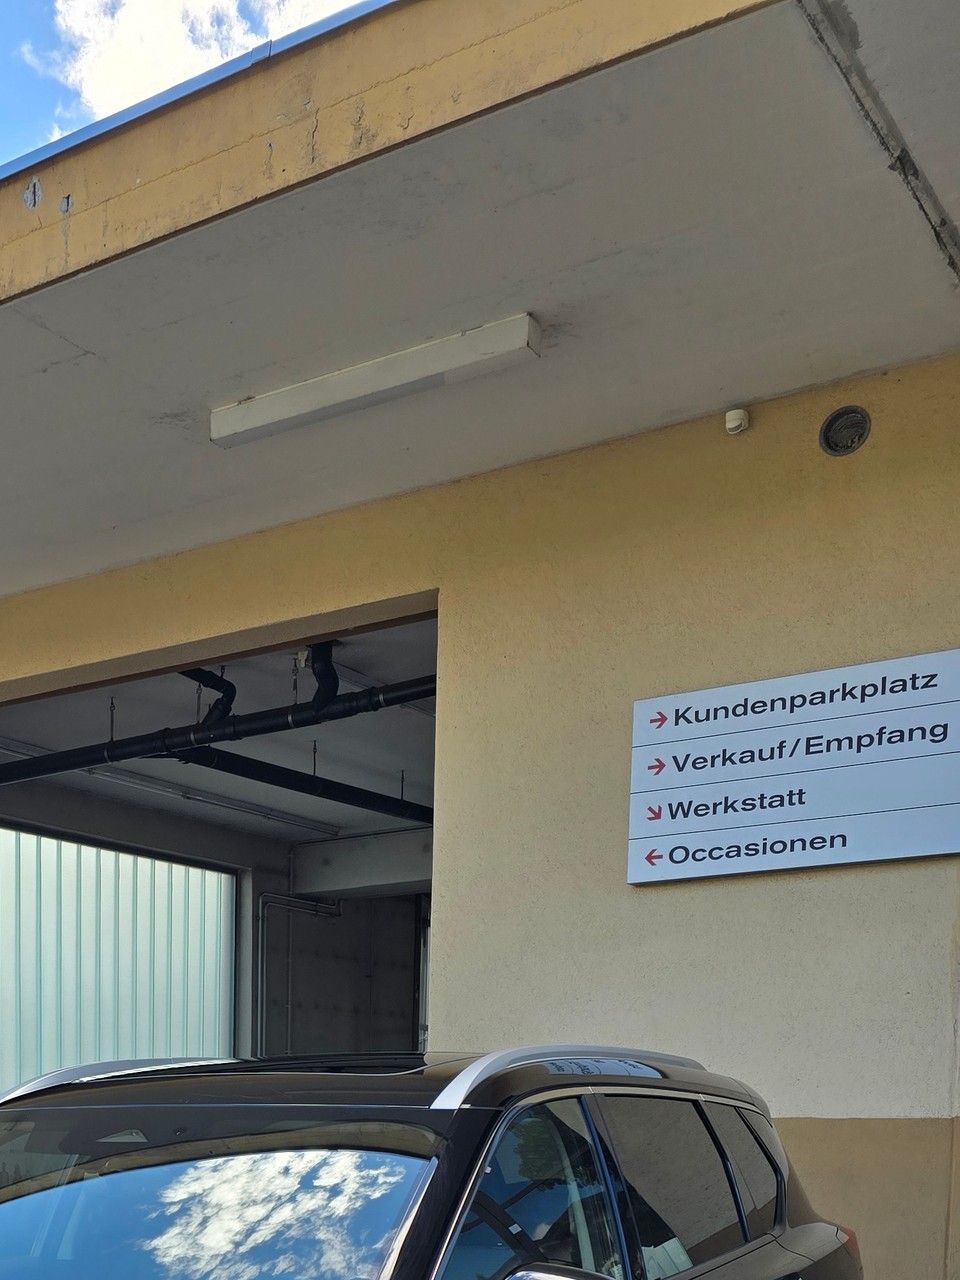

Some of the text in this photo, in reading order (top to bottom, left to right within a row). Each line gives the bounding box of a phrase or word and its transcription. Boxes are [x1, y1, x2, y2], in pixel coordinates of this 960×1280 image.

[673, 672, 939, 727] Kundenparkplatz
[672, 722, 949, 773] Verkauf/Empfang
[667, 788, 807, 820] Werkstatt
[668, 833, 848, 865] Occasionen
